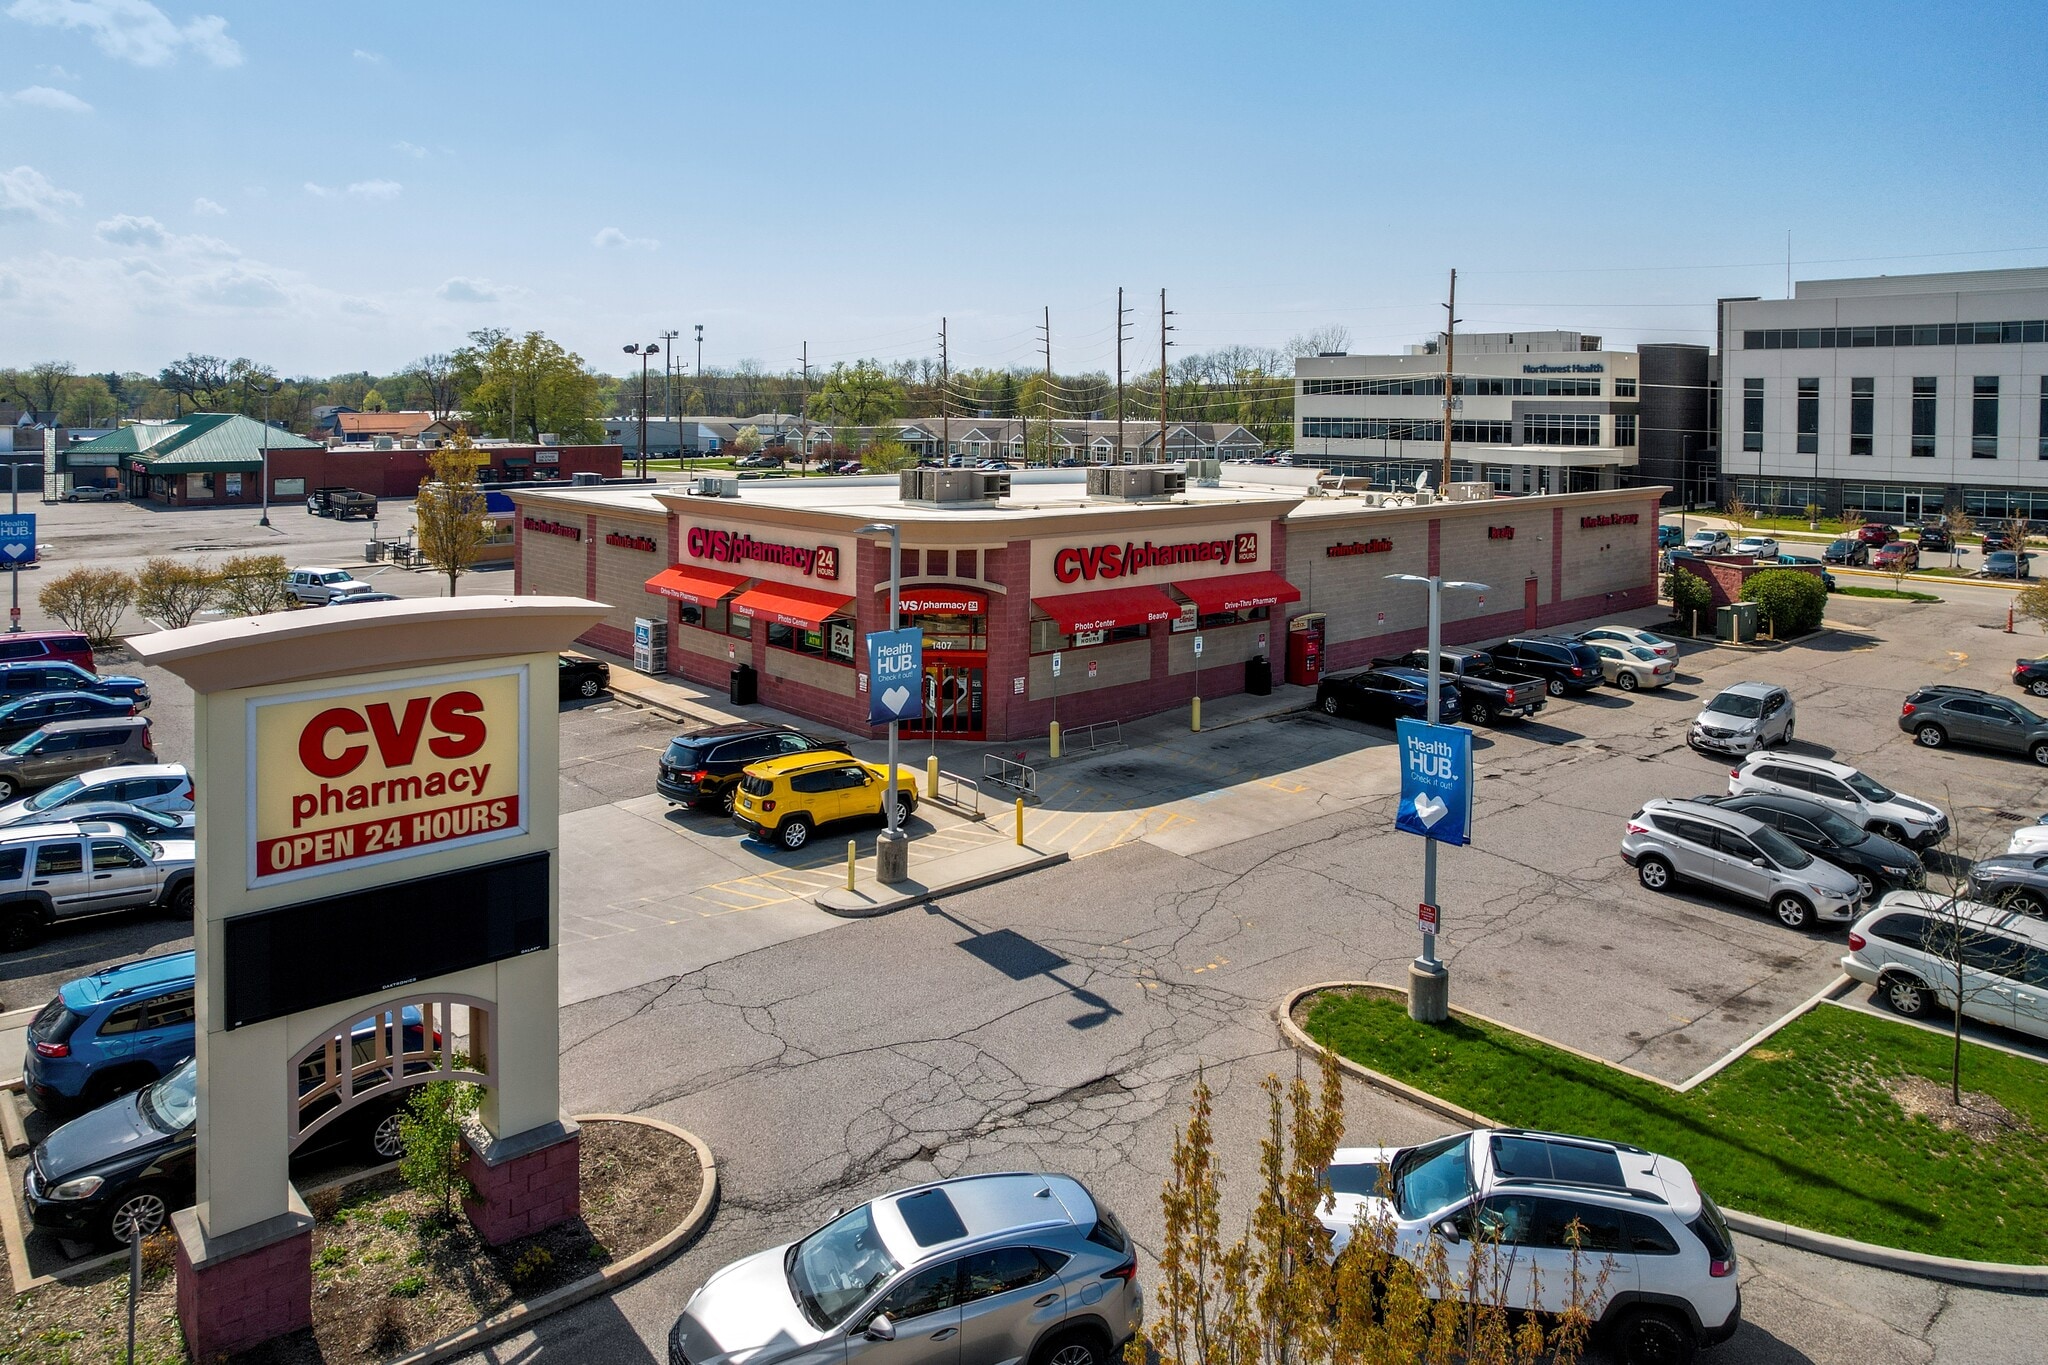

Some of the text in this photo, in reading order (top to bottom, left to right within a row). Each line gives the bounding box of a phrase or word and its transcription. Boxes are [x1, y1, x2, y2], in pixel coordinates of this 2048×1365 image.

[1523, 363, 1603, 374] Northwest Health
[0, 526, 29, 536] HUB
[688, 527, 816, 575] CVS/pharmacy
[1239, 536, 1256, 552] 24
[818, 549, 834, 567] 24
[1054, 541, 1234, 583] CVS/pharmacy
[1239, 551, 1256, 561] HOURS
[818, 567, 834, 577] HOURS
[660, 587, 698, 603] Drive-Thru Pharmacy
[898, 600, 967, 611] VS/pharmacy
[1225, 597, 1277, 609] Drive-Thru Pharmacy
[739, 605, 755, 617] Beauty
[1148, 612, 1168, 620] Beauty
[778, 614, 808, 628] Photo Center
[1074, 619, 1115, 631] Photo Center
[809, 636, 820, 645] ATM
[835, 631, 850, 648] 24
[932, 641, 952, 650] 1407
[1081, 636, 1100, 644] HOURS
[834, 645, 850, 654] HOURS
[878, 643, 912, 657] Health
[878, 654, 912, 675] HUB
[878, 674, 897, 682] Check
[298, 691, 487, 778] CVS
[1407, 735, 1452, 758] Health
[1409, 751, 1452, 780] HUB
[1411, 771, 1453, 790] Check it out!
[293, 764, 491, 829] pharmacy
[270, 801, 508, 871] OPEN 24 HOURS
